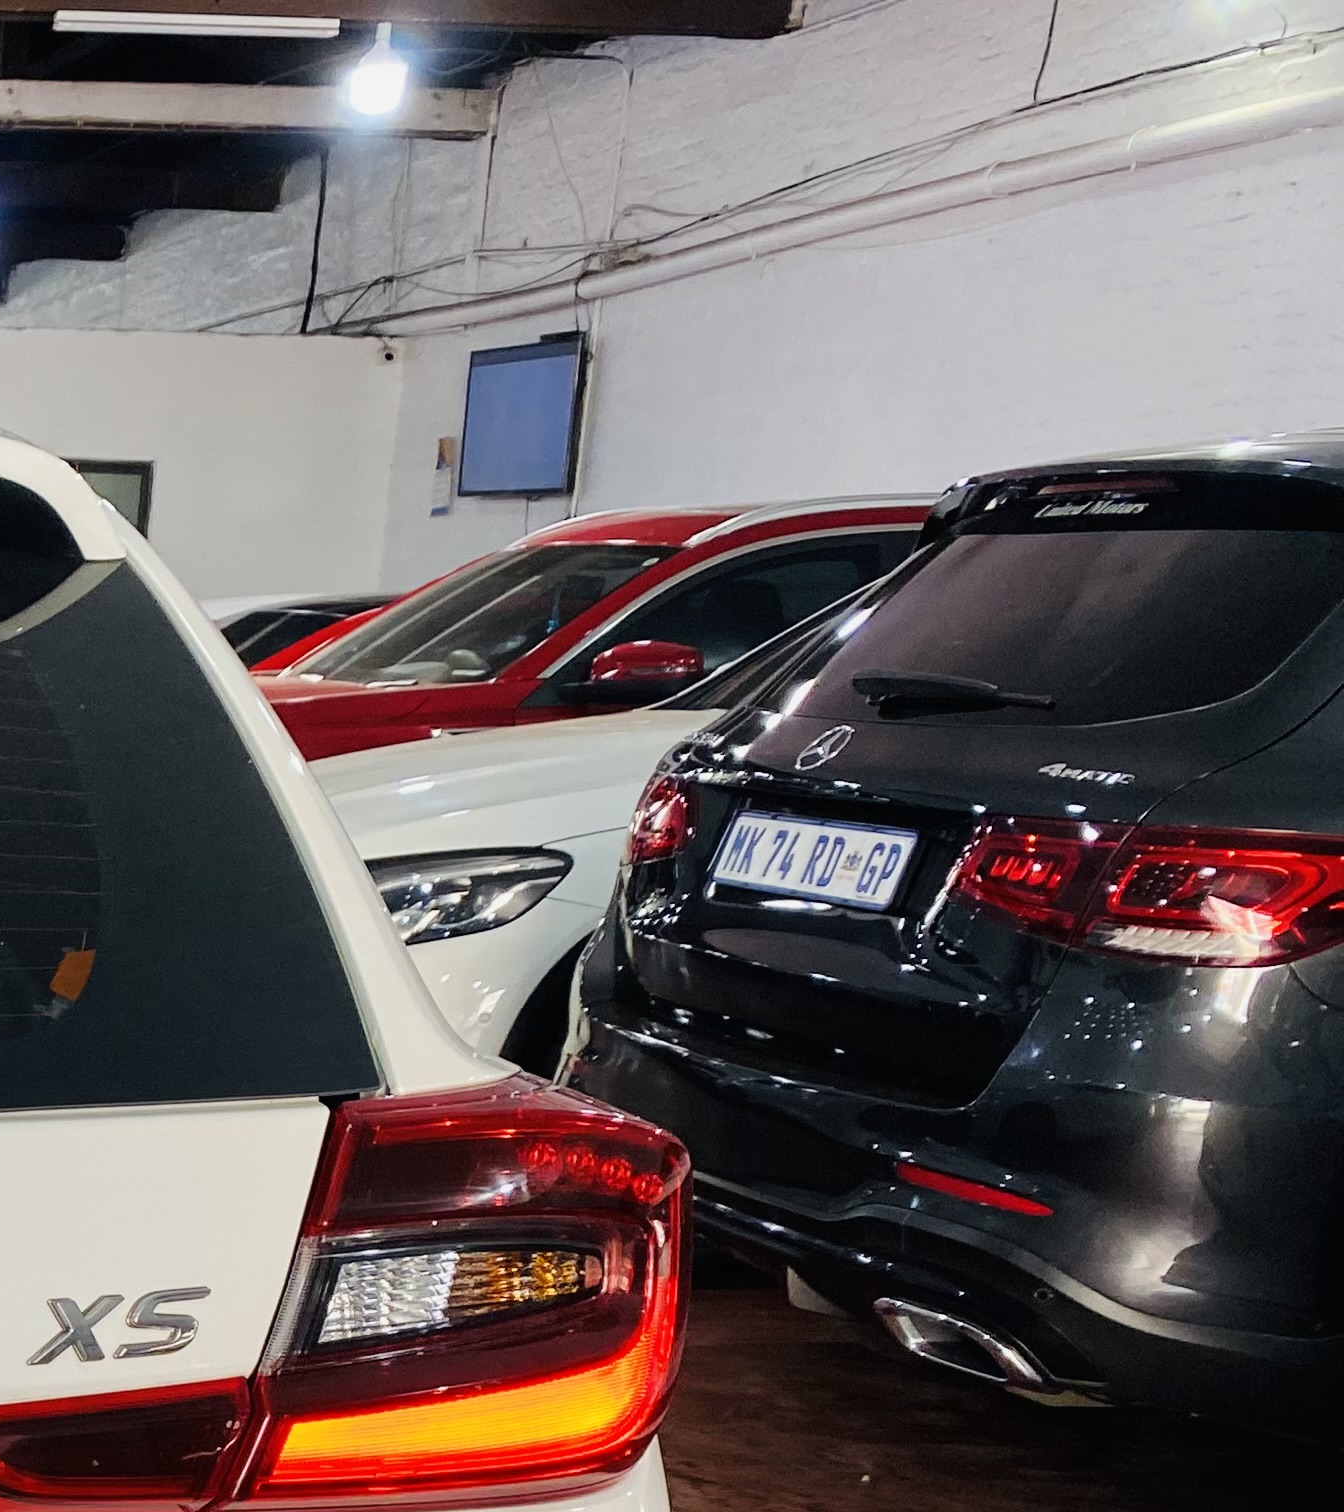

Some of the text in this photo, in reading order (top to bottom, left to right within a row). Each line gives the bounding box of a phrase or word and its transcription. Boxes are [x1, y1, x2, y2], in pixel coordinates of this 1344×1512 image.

[723, 825, 902, 896] MK 74 RD GP
[25, 1286, 212, 1366] XS
